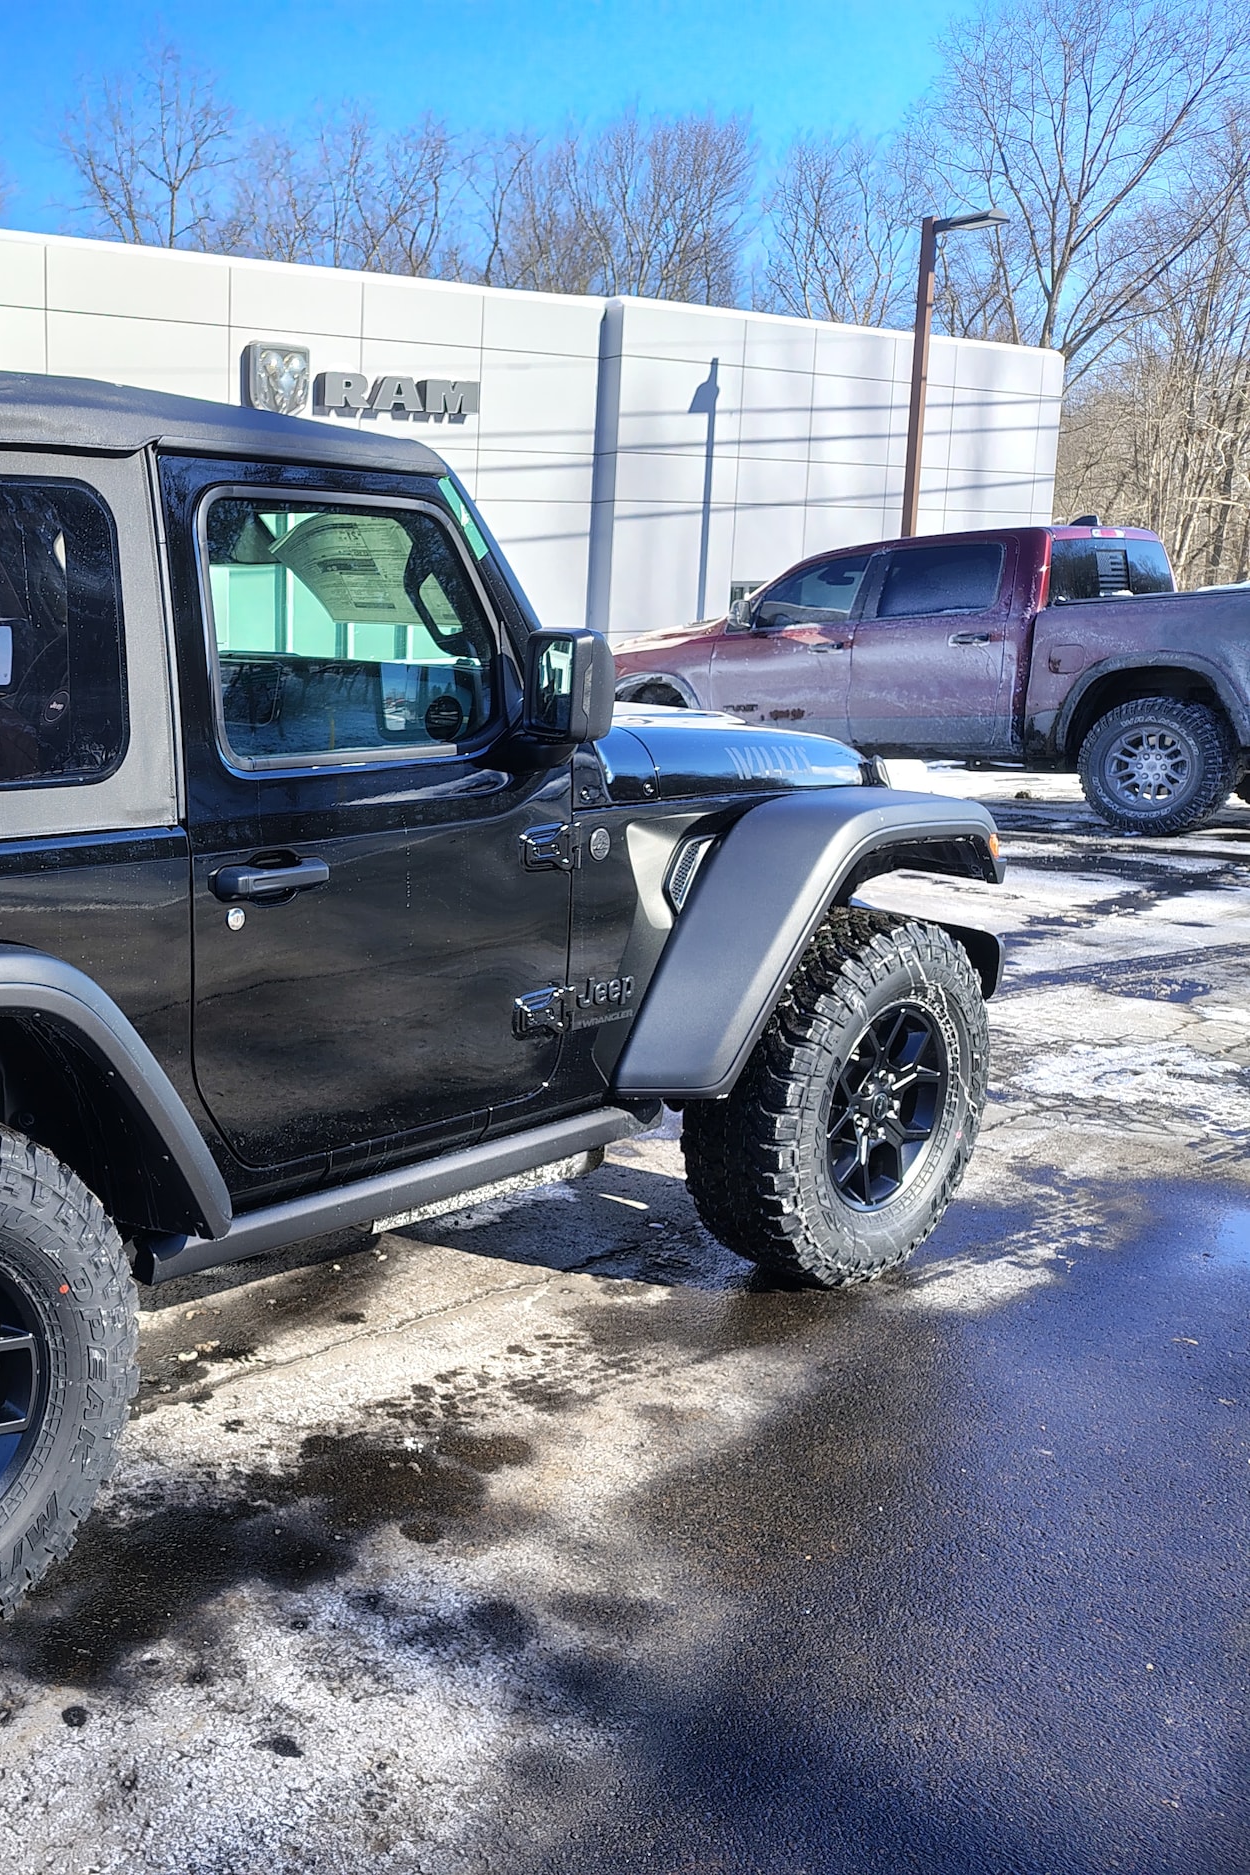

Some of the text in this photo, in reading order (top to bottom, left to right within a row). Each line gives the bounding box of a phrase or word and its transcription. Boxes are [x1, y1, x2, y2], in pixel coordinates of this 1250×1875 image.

[323, 371, 481, 414] RAM
[1120, 715, 1199, 757] WRANGLER
[577, 975, 635, 1009] Jeep
[582, 1009, 634, 1028] WRANGLER
